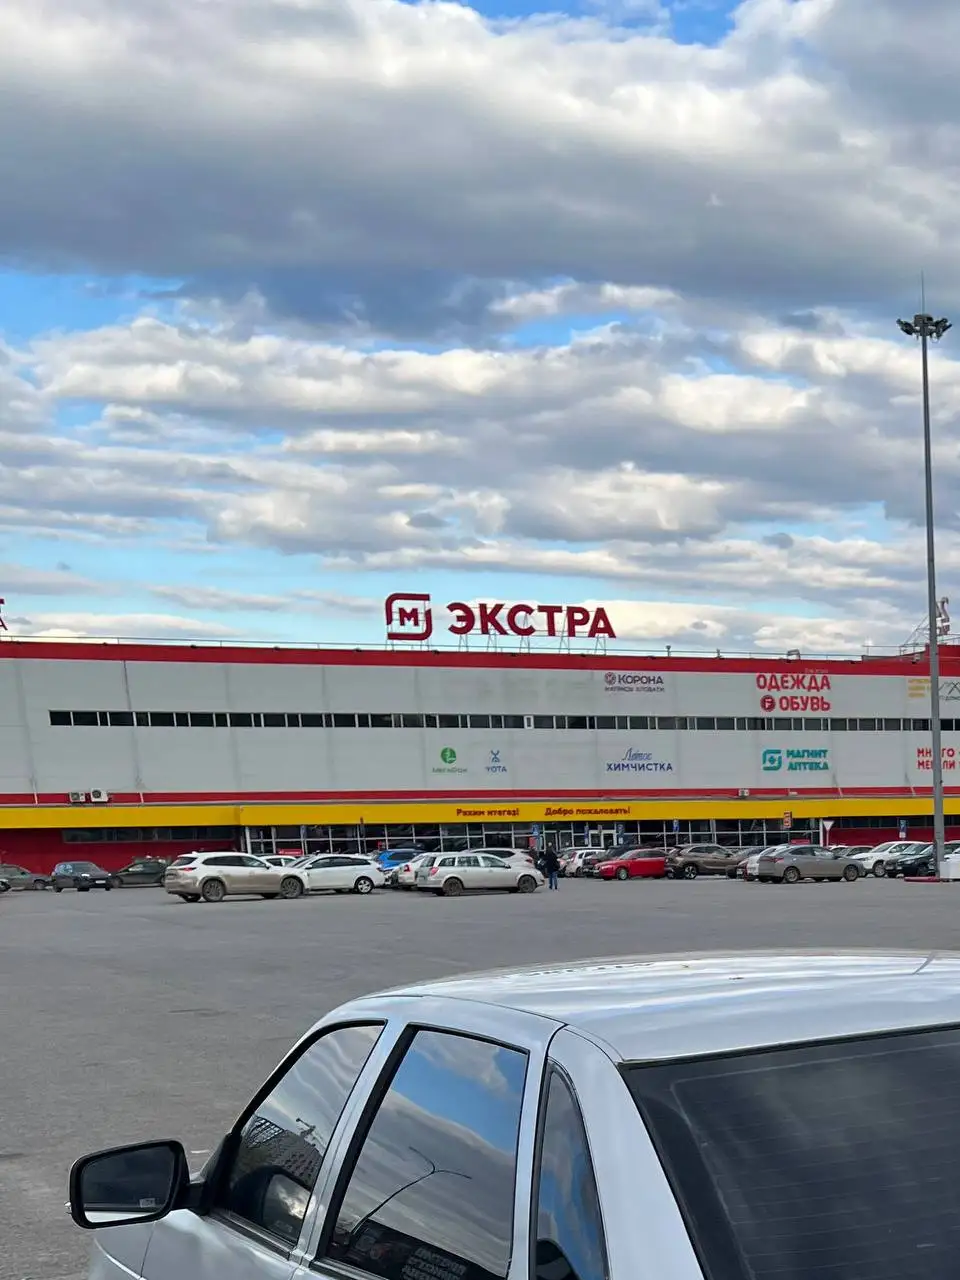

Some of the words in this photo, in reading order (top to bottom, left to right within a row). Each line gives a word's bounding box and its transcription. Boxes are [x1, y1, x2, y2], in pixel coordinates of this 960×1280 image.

[446, 602, 616, 638] ЭКСТРА
[618, 674, 664, 685] КОРОНА
[756, 674, 831, 691] ОДЕЖДА
[779, 696, 831, 711] ОБУВЬ
[917, 748, 955, 758] МНГО
[606, 762, 673, 771] ХИМЧИСТКА
[917, 760, 955, 769] МЕЛИ
